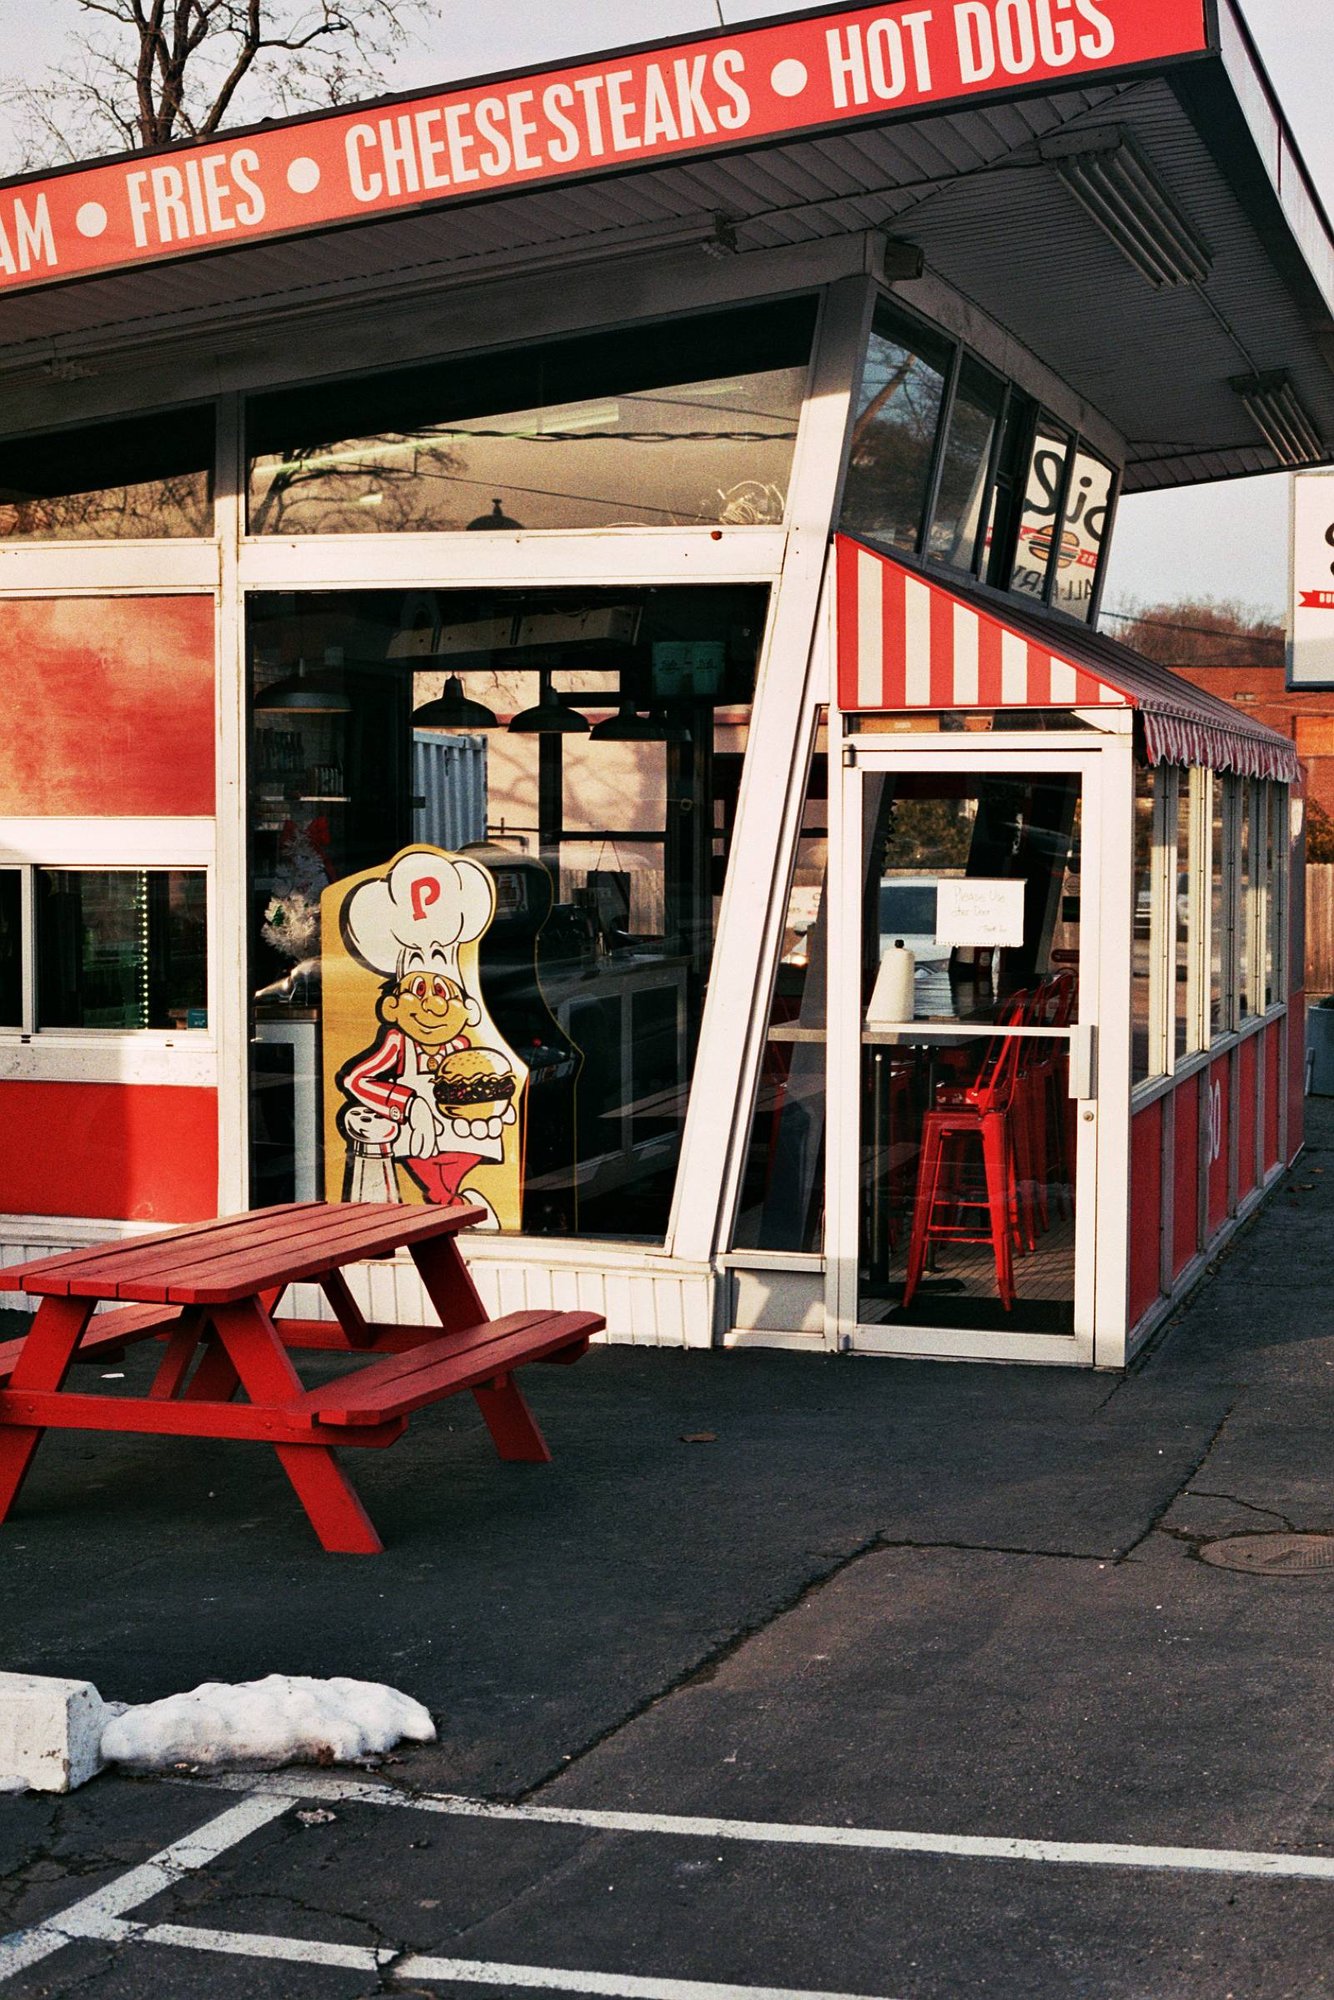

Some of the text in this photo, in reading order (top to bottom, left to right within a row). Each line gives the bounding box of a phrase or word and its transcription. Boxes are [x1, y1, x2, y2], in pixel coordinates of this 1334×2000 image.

[126, 149, 266, 248] FRIES
[345, 49, 751, 202] CHEESESTEAKS
[825, 11, 934, 109] HOT
[953, 0, 1115, 84] DOGS
[410, 876, 441, 921] P
